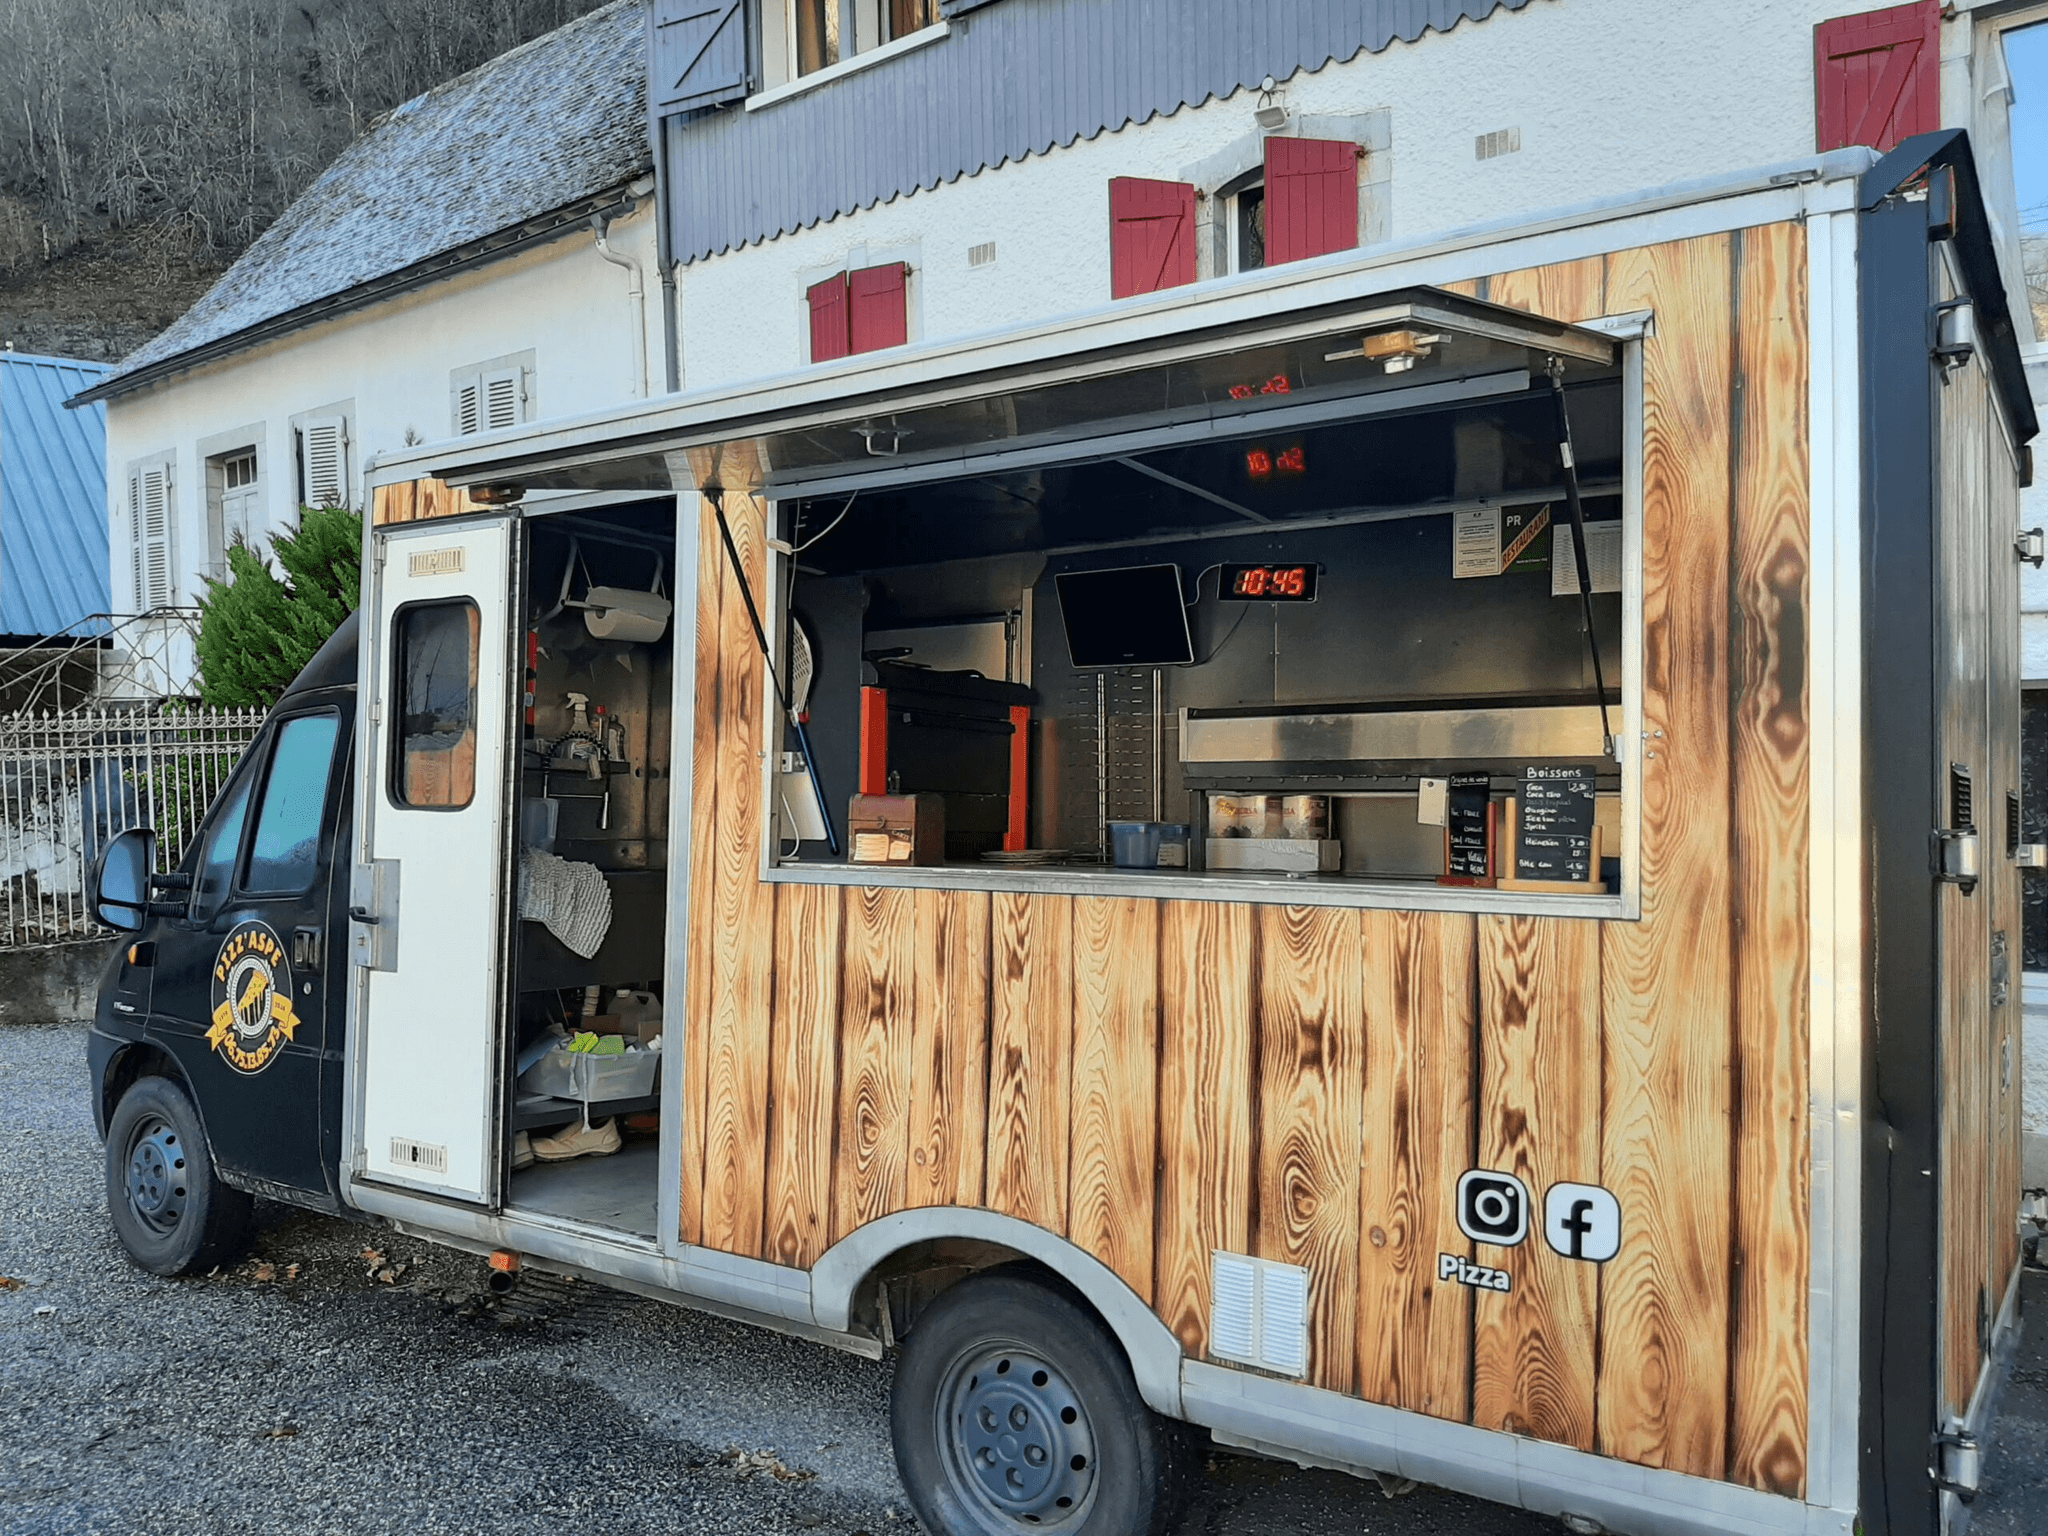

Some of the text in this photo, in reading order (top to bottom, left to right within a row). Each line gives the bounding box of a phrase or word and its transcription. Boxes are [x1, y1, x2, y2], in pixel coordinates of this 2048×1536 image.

[1506, 515, 1521, 527] PR
[1503, 508, 1549, 567] RESTAURANT
[1240, 568, 1305, 595] 10:45
[1527, 766, 1582, 778] Boissons
[1526, 783, 1543, 791] Coca
[216, 930, 282, 982] PIZZ'ASPE
[1439, 1253, 1511, 1292] Pizza
